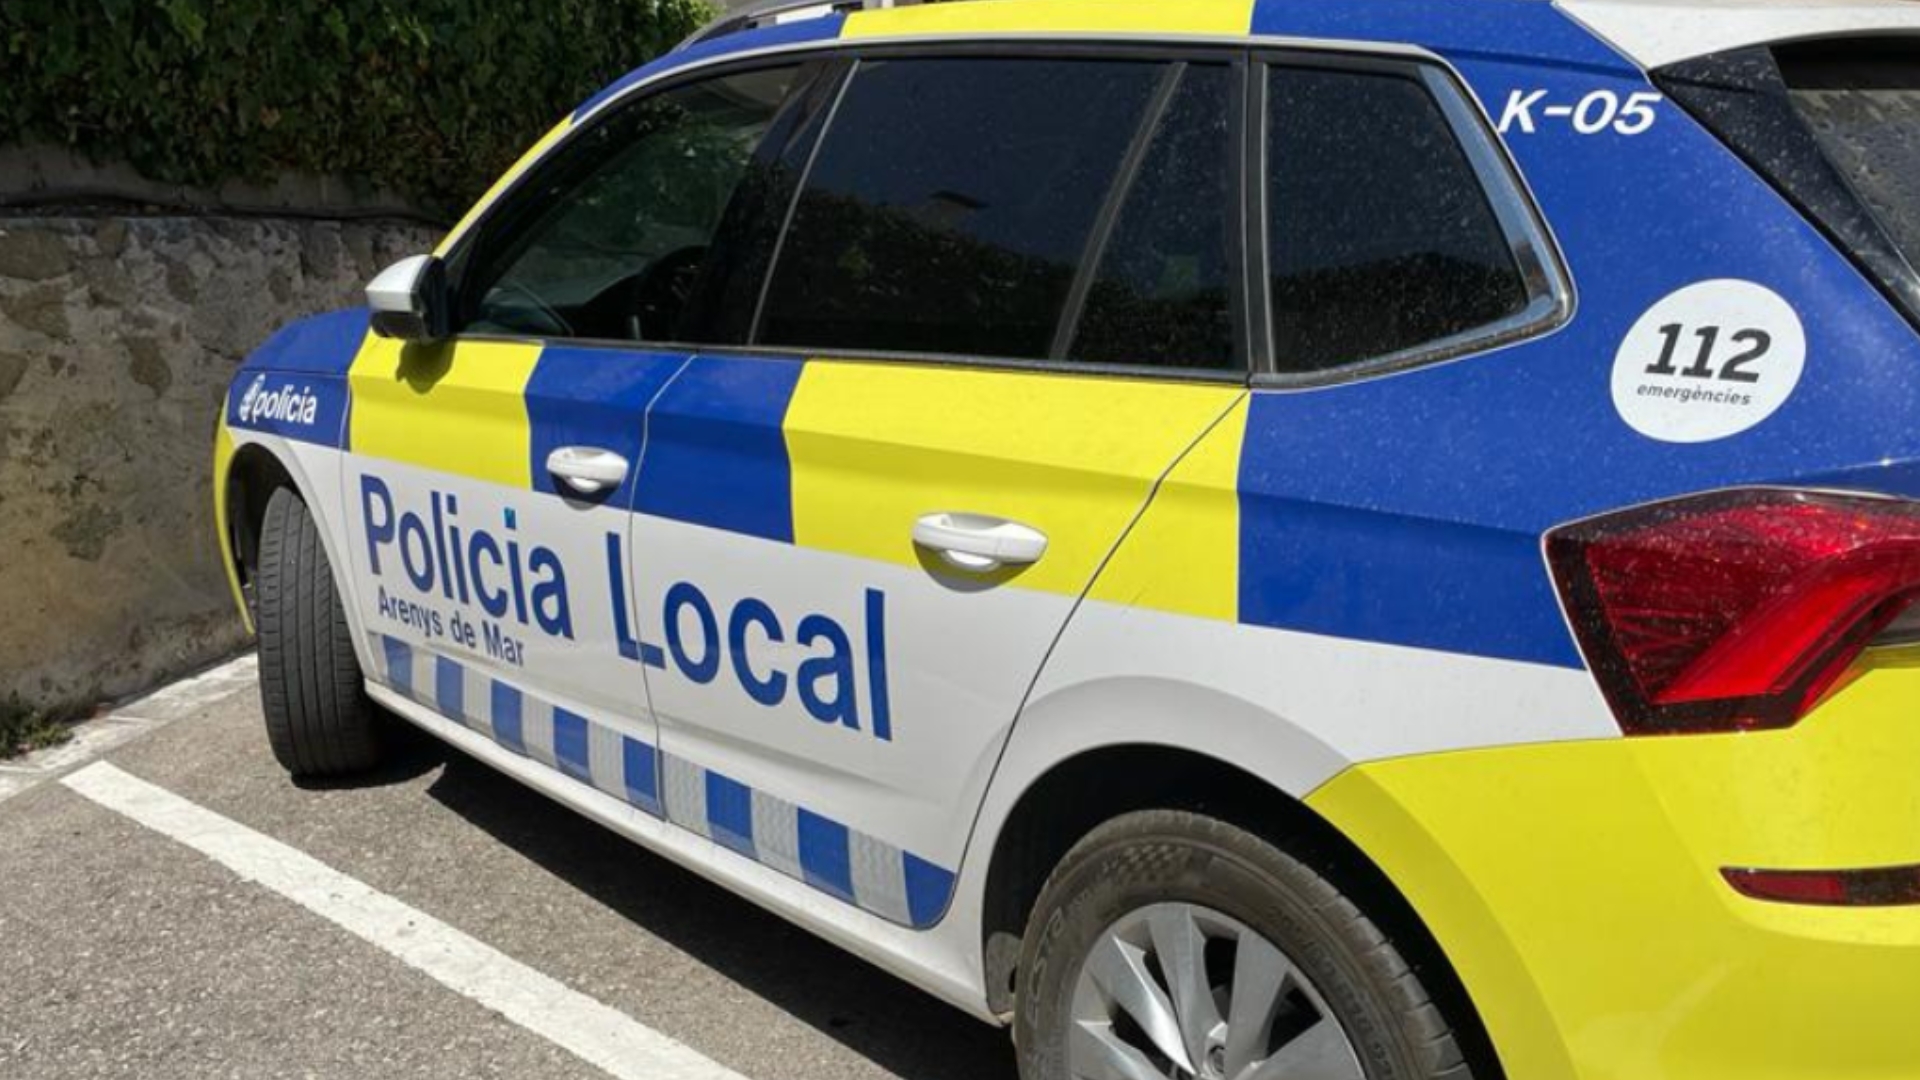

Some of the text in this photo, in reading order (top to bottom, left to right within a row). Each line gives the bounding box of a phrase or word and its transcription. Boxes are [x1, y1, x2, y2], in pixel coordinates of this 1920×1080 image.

[1498, 89, 1664, 135] K-05
[1644, 322, 1772, 383] 112
[1637, 383, 1752, 406] emergències
[360, 473, 893, 742] Policia Local
[378, 585, 525, 667] Arenys de Mar
